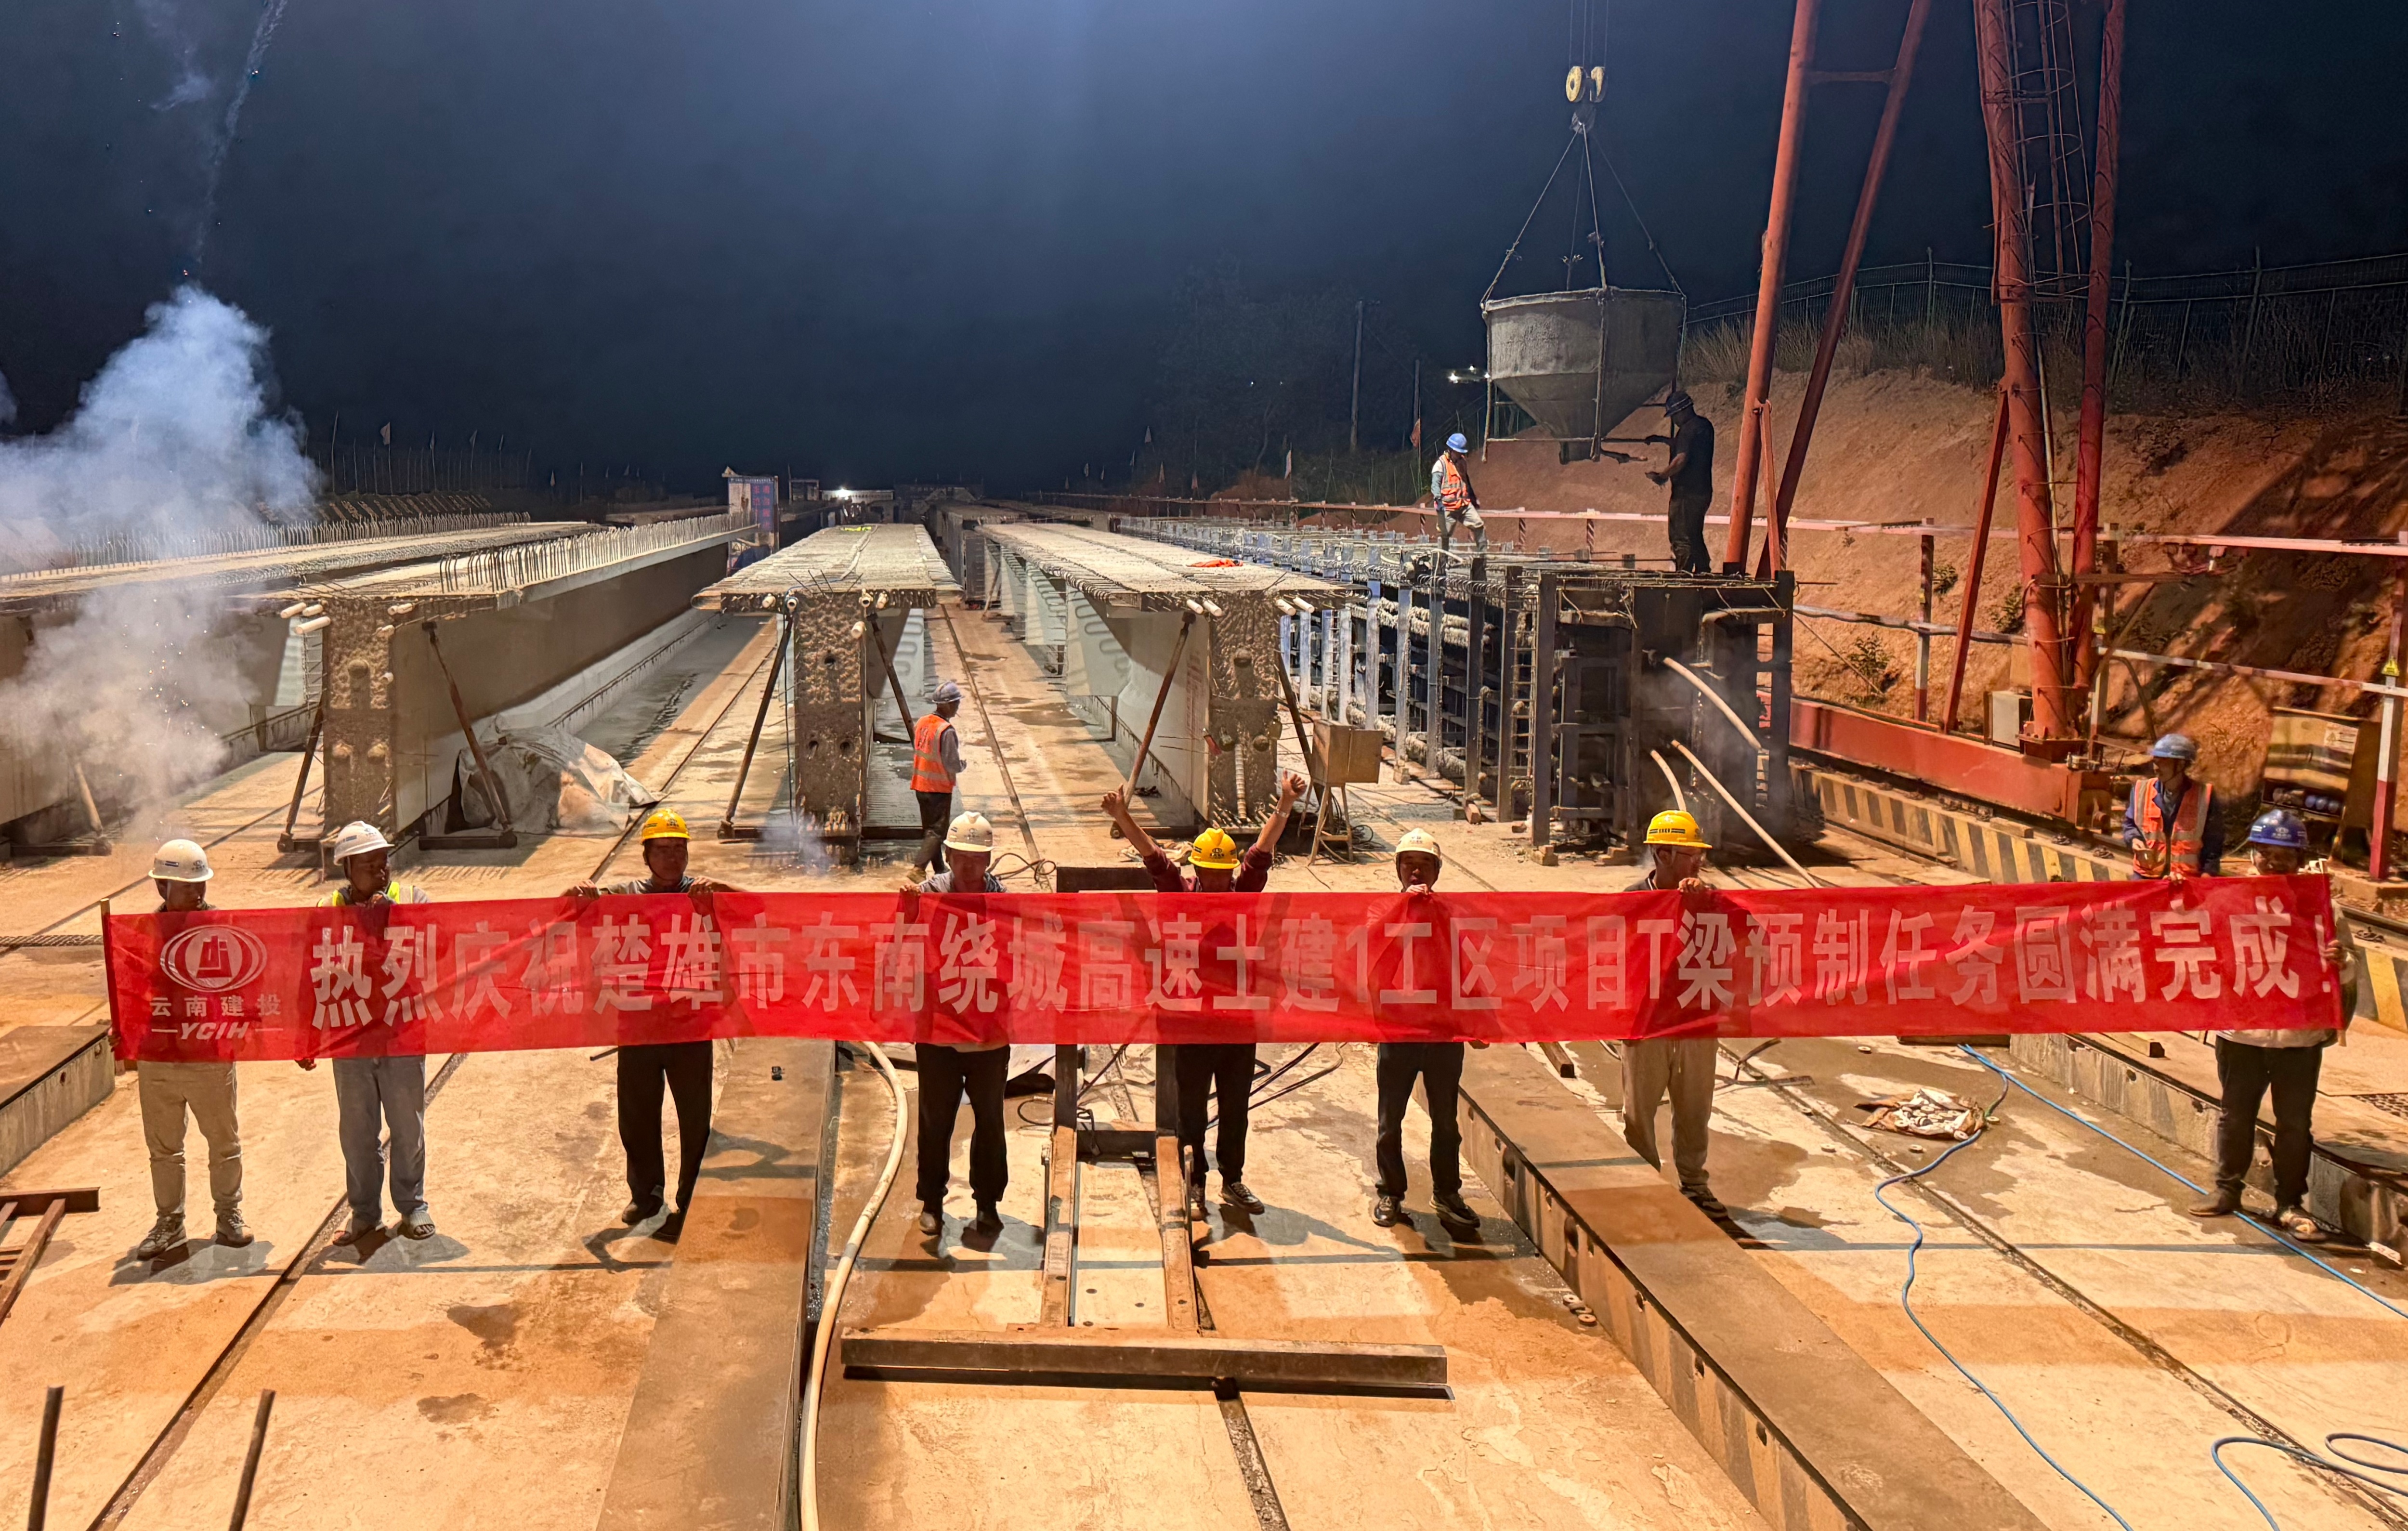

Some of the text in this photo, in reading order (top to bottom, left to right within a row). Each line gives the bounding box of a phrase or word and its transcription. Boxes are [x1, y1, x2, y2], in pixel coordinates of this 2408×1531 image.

[150, 994, 281, 1017] 云南建投
[180, 1022, 249, 1040] YCIH
